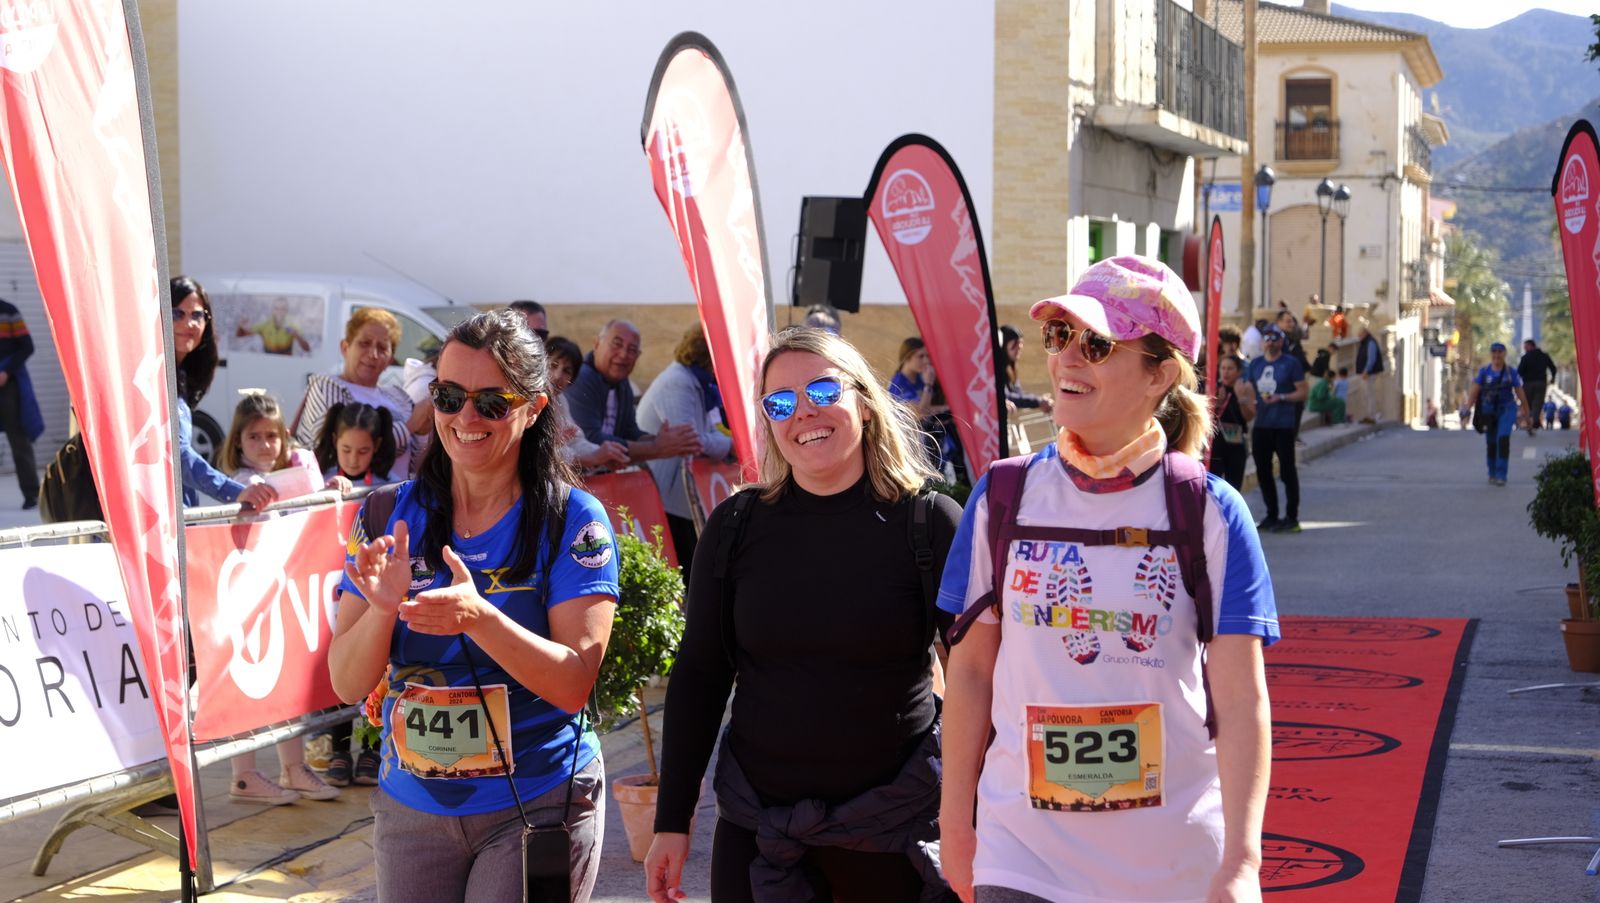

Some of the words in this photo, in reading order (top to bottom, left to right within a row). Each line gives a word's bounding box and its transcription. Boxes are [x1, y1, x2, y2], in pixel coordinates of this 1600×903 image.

[1015, 541, 1080, 566] RUTA
[1009, 569, 1041, 594] DE
[2, 608, 67, 643] NTO
[84, 600, 127, 632] DE
[1012, 601, 1173, 636] SENDERISMO
[1103, 655, 1130, 665] Grupo
[406, 707, 479, 739] 441
[1037, 714, 1046, 723] LA
[1100, 708, 1133, 717] CANTORIA
[1045, 729, 1138, 764] 523
[1068, 772, 1114, 780] ESMERALDA
